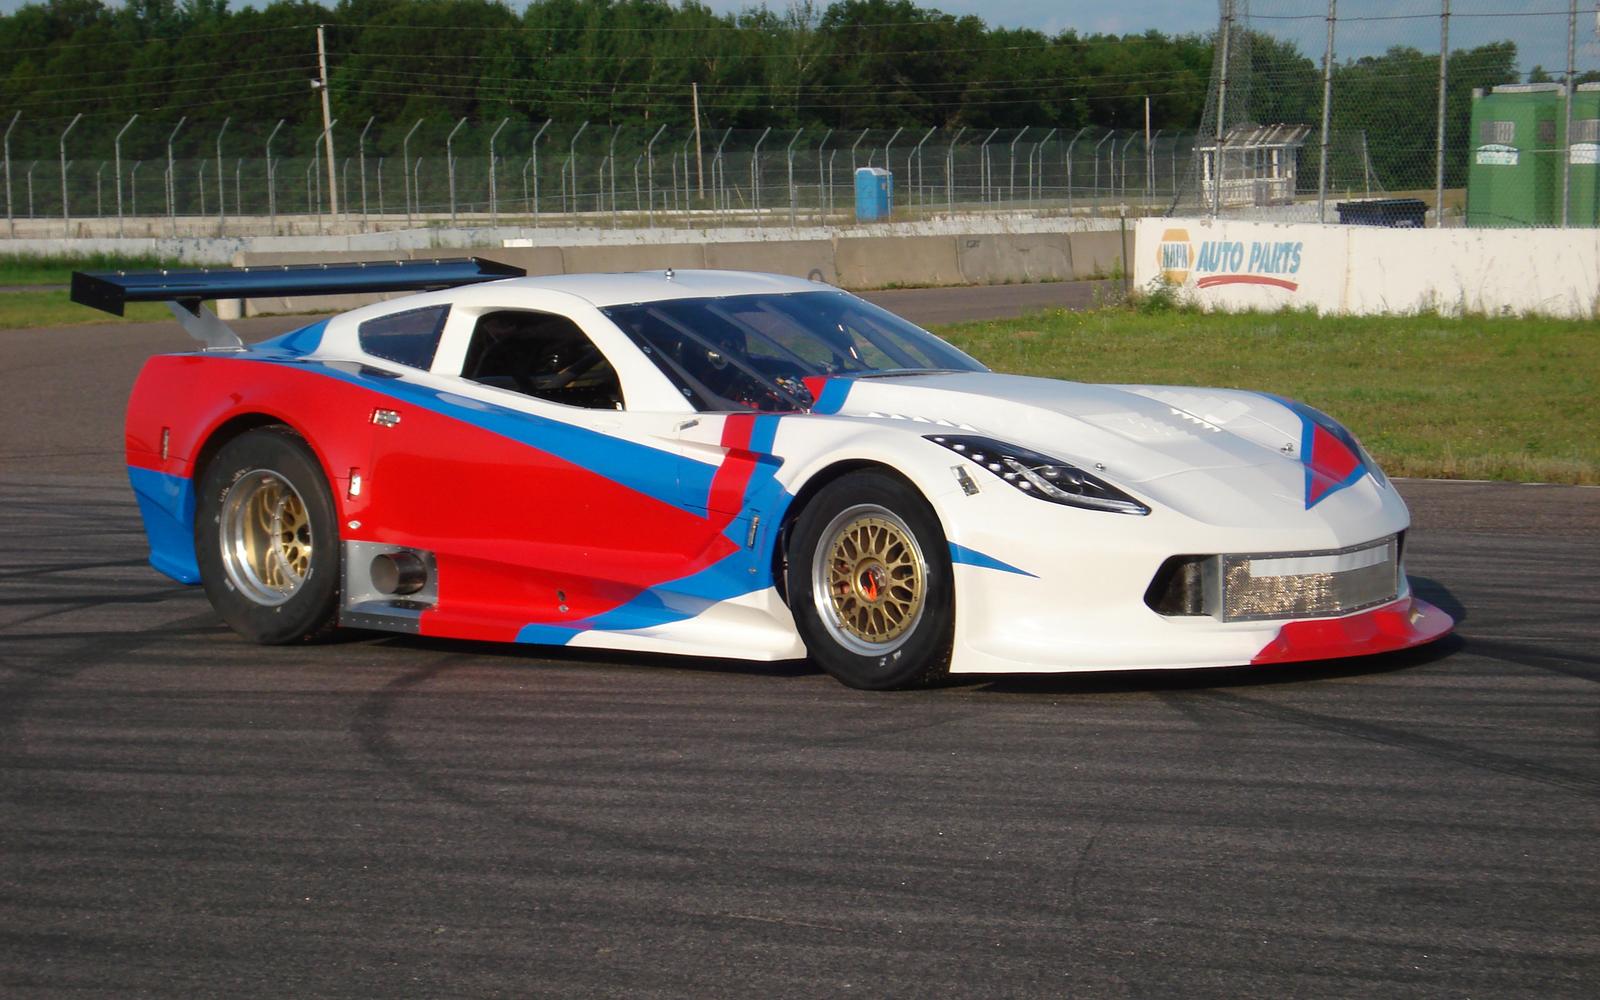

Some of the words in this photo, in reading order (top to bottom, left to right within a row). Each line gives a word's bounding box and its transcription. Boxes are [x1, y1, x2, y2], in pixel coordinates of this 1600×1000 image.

[1163, 243, 1188, 268] NAPA
[1196, 241, 1245, 272] AUTO
[1248, 241, 1303, 273] PARTS
